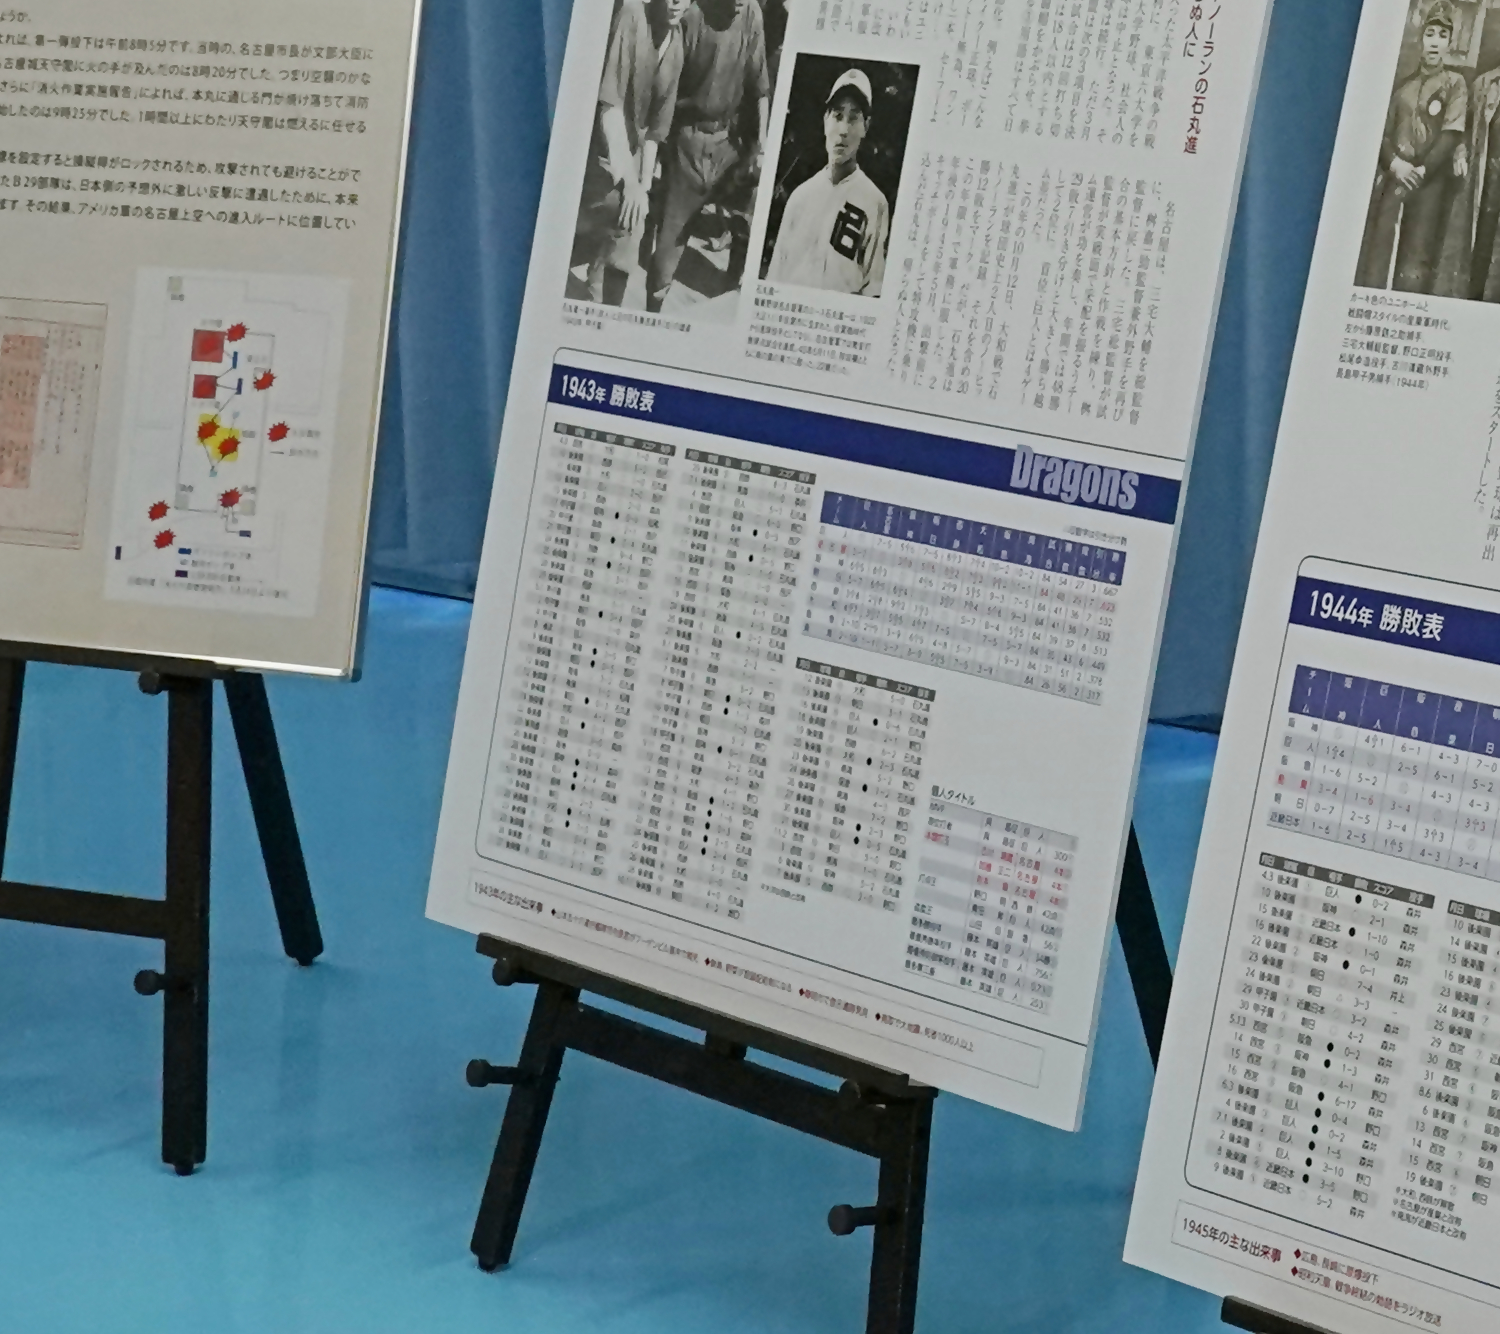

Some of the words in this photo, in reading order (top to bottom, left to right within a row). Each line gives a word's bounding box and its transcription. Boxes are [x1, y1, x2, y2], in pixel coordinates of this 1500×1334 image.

[561, 374, 606, 403] 1943年
[609, 383, 656, 413] 勝敗表
[1009, 444, 1139, 511] Dragons
[1308, 589, 1374, 629] 1944年
[1379, 603, 1445, 642] 勝敗表
[1181, 1216, 1282, 1264] 1945年の主な出来事
